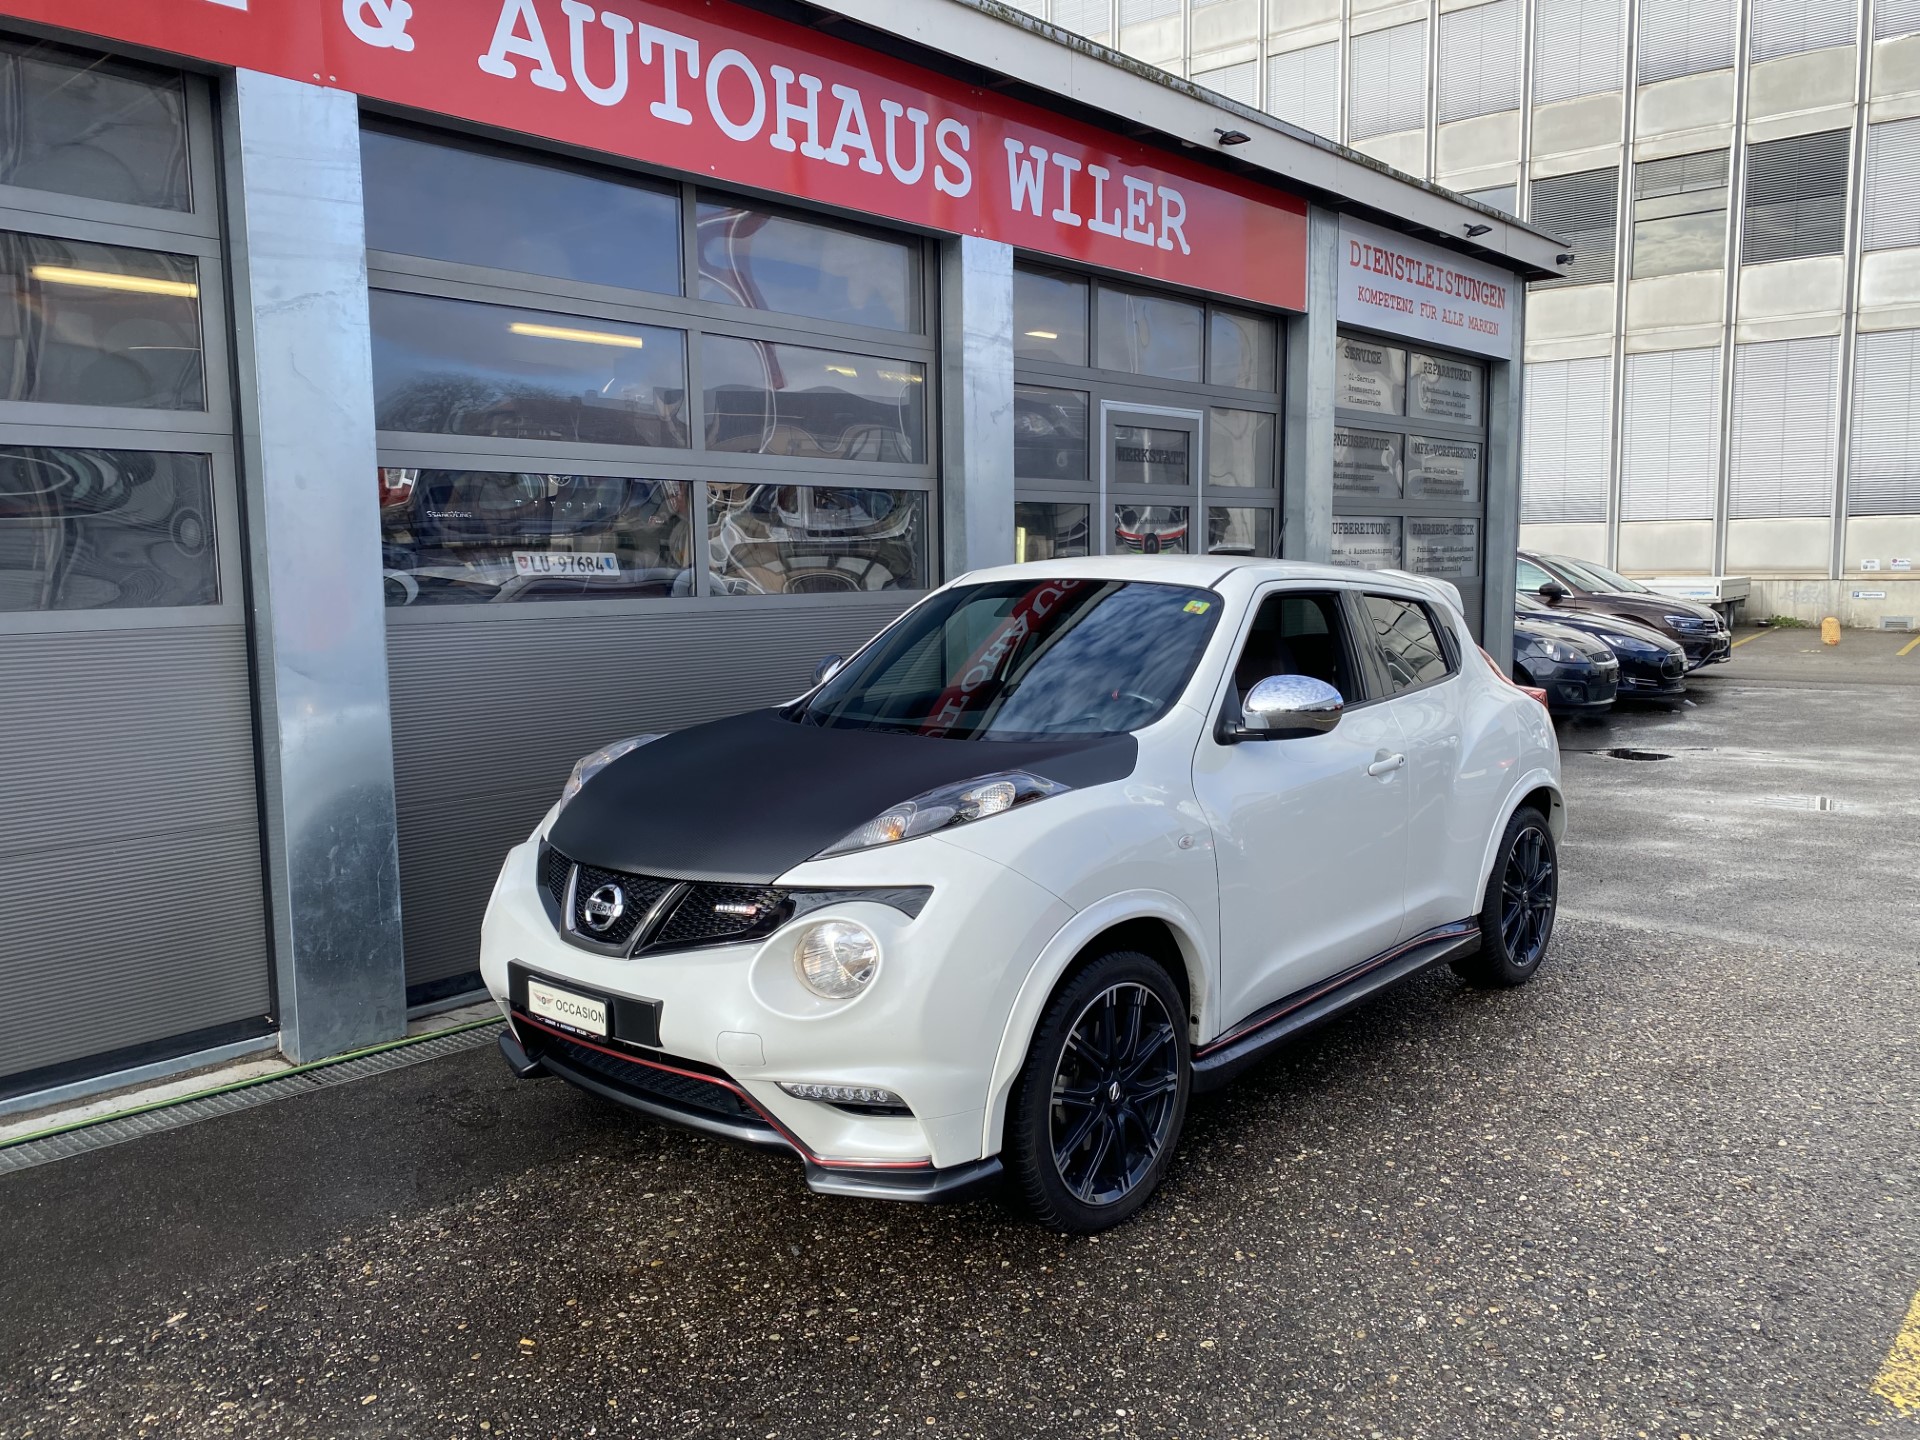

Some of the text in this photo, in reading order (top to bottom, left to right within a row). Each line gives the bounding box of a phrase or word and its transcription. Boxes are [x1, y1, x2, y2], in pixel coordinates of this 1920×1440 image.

[478, 0, 972, 199] AUTOHAUS
[1003, 136, 1191, 256] WILER
[1349, 239, 1506, 310] DIENSTLEISTUNGEN
[1357, 285, 1499, 336] KOMPETENZ FÜR ALLE MARKEN
[1344, 346, 1382, 364] SERVICE
[1423, 361, 1472, 382] REPARATUREN
[1116, 446, 1185, 465] WERKSTATT
[1332, 522, 1391, 535] UFBEREITUNG
[1412, 523, 1475, 536] FAHRZEUG-CHECK
[586, 901, 615, 915] NISSAN
[555, 999, 605, 1024] OCCASION
